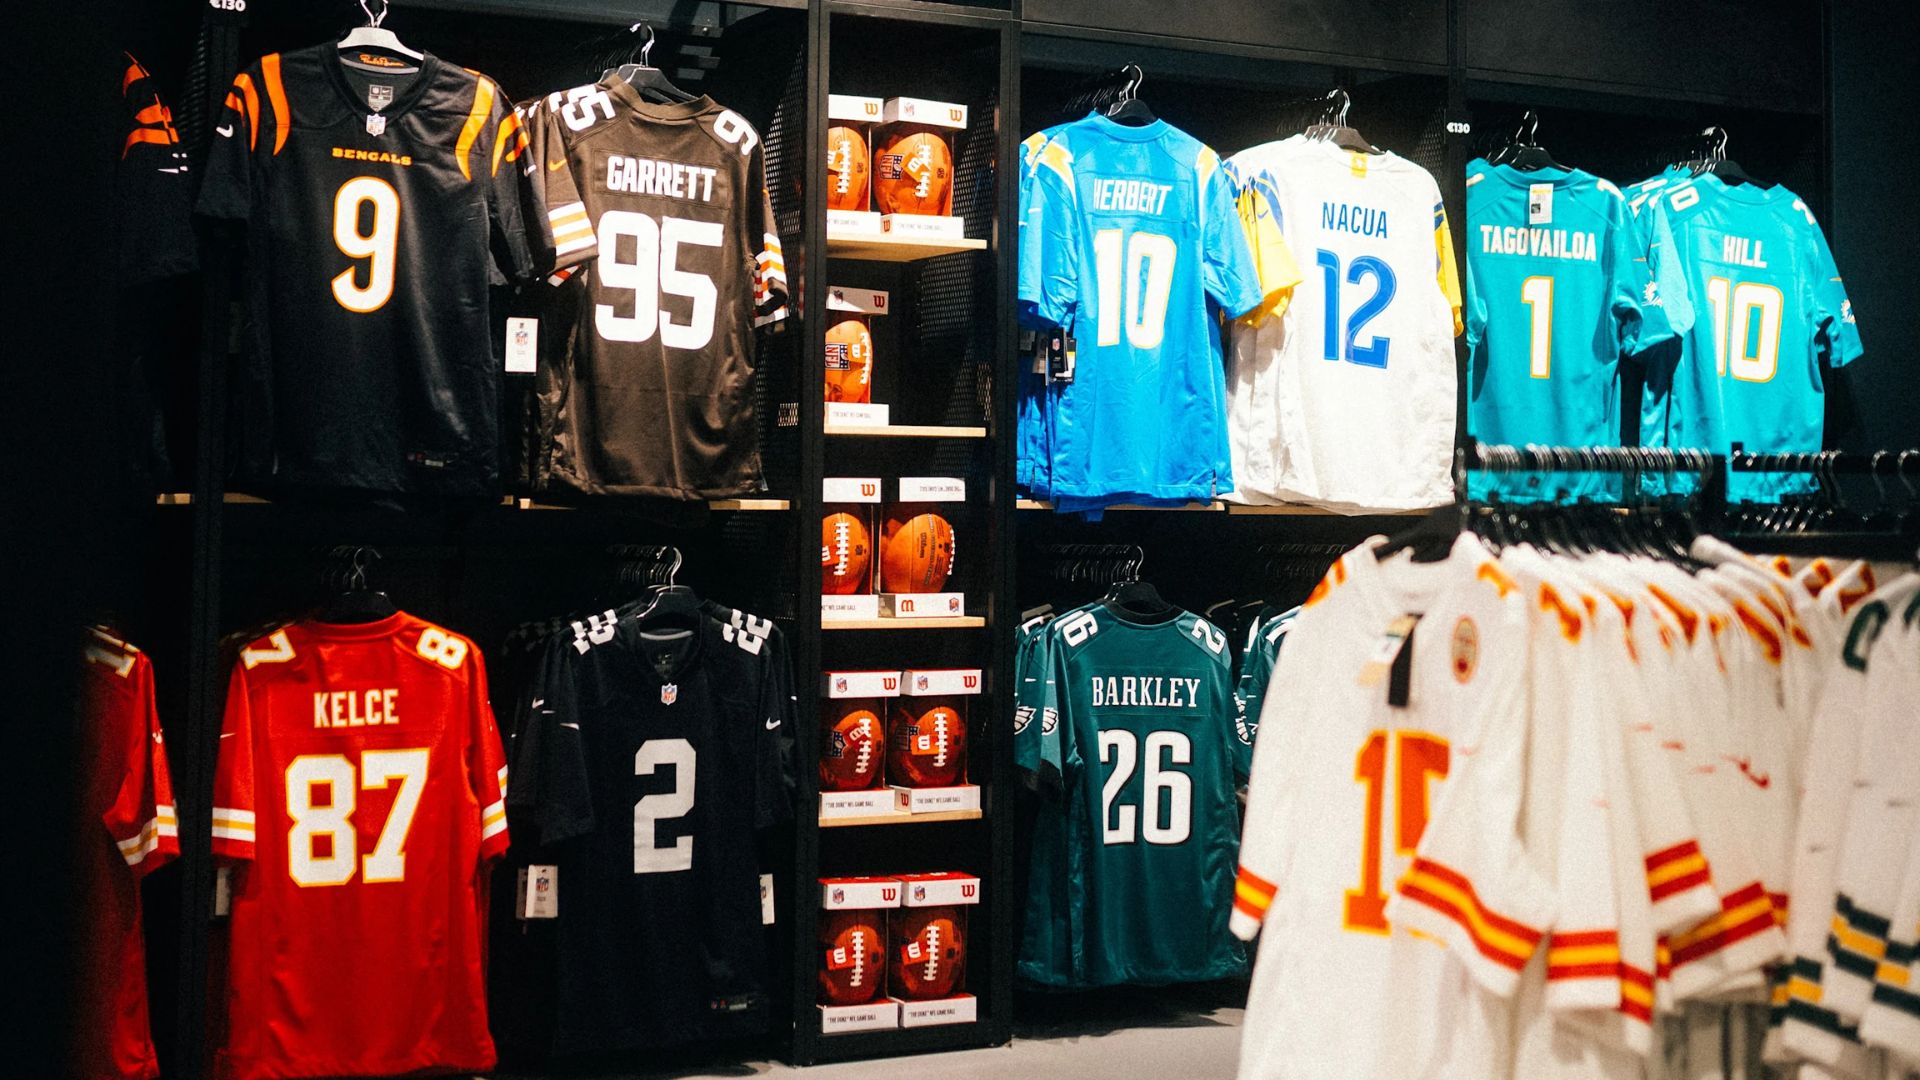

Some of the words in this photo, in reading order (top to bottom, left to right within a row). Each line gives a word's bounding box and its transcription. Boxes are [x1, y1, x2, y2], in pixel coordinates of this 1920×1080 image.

[1446, 121, 1471, 134] €130
[332, 147, 412, 166] BENGALS
[607, 155, 717, 202] GARRETT
[1094, 178, 1172, 216] HERBERT
[1322, 202, 1388, 239] NACUA
[331, 176, 401, 313] 9
[1479, 225, 1596, 262] TAGOVAILOA
[1723, 235, 1767, 269] HILL
[595, 210, 724, 350] 95
[1093, 228, 1177, 350] 10
[1316, 248, 1397, 370] 12
[1521, 275, 1554, 380] 1
[1707, 276, 1784, 383] 10
[240, 628, 297, 671] 7
[416, 628, 468, 670] 8
[1062, 612, 1098, 648] 6
[1191, 618, 1227, 655] 2
[314, 688, 399, 728] KELCE
[1091, 676, 1201, 708] BARKLEY
[634, 738, 697, 874] 2
[1097, 729, 1192, 847] 26
[285, 748, 430, 888] 87
